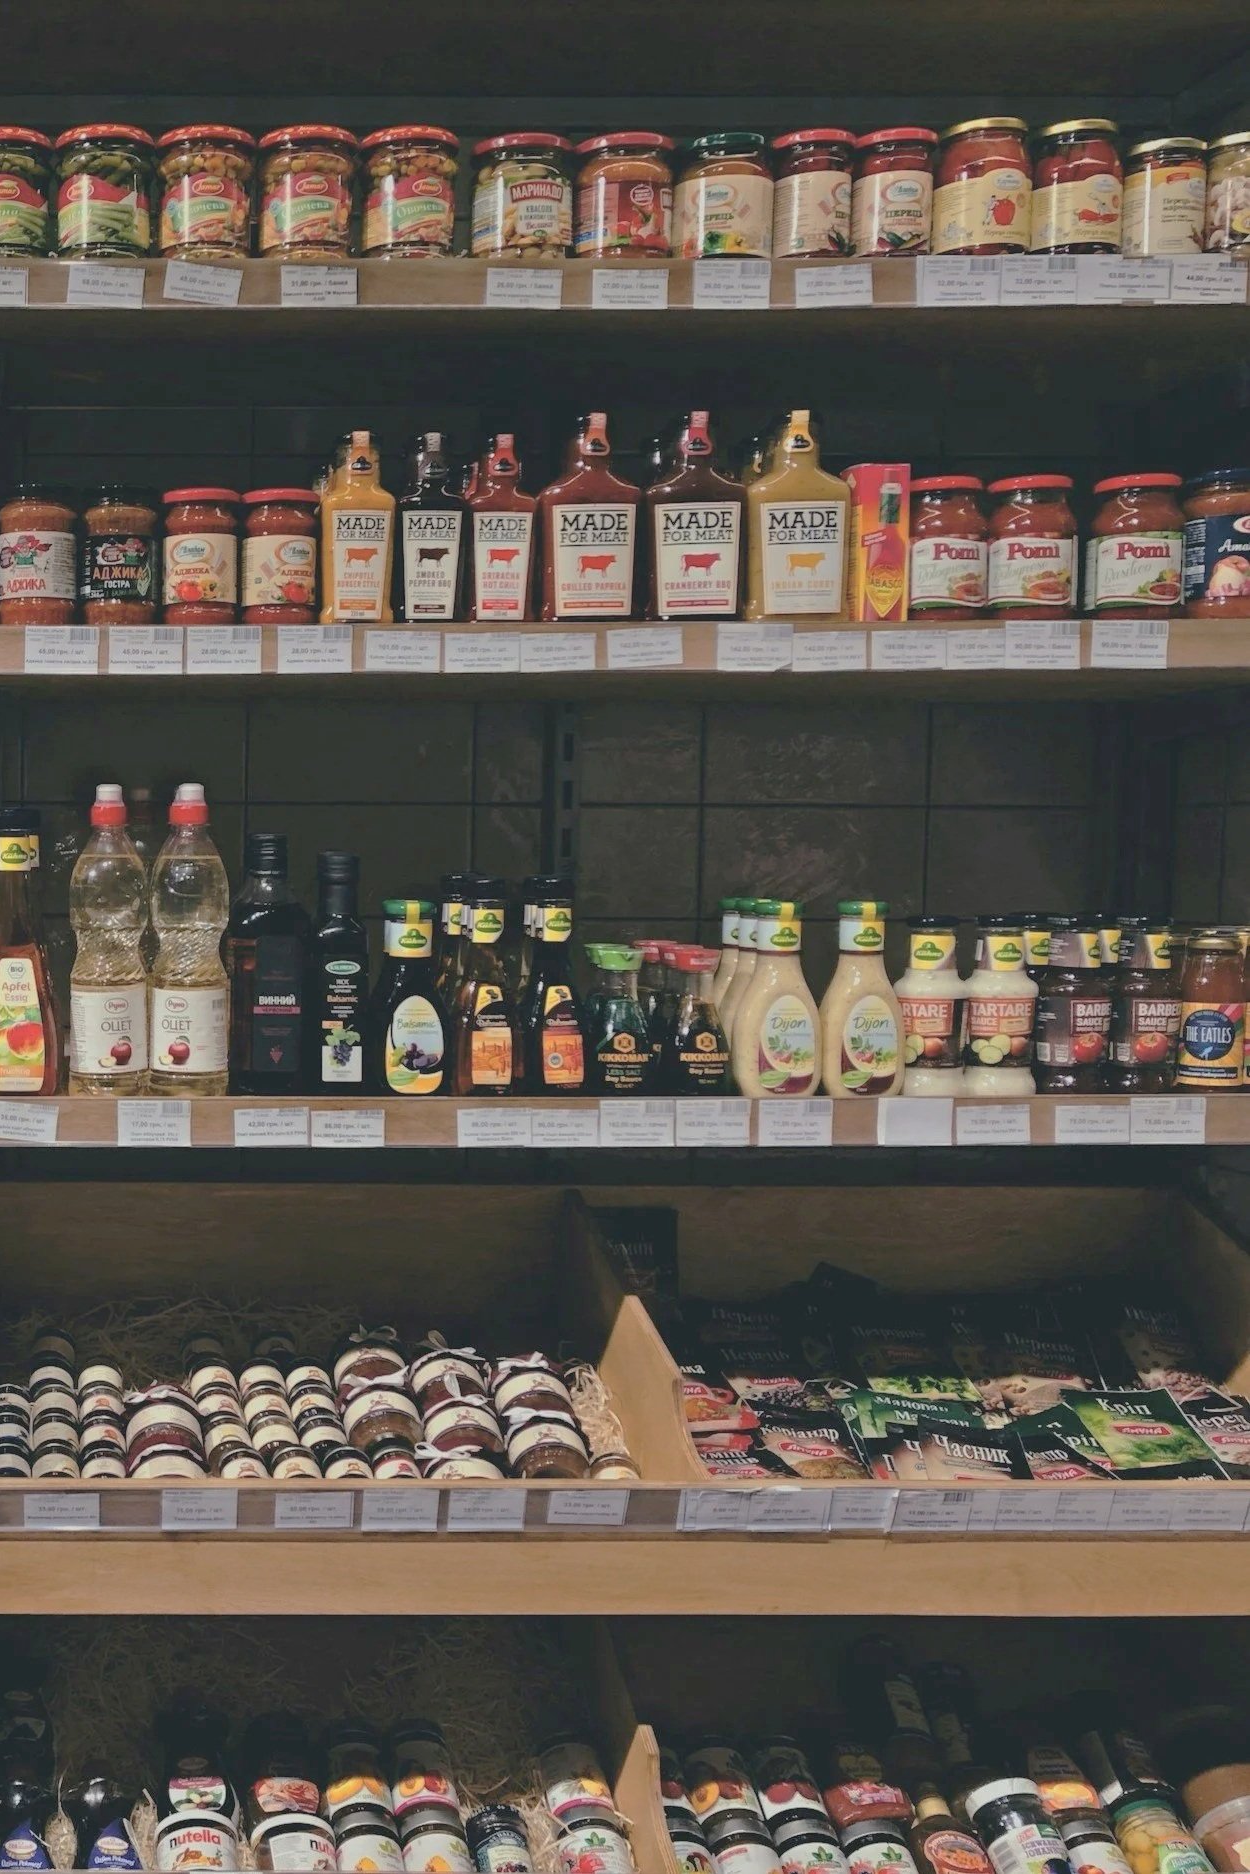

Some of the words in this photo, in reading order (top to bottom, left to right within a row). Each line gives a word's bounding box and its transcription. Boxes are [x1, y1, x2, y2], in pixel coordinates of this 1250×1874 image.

[512, 182, 563, 200] МАРИНАДО
[337, 517, 385, 530] MADE
[408, 517, 456, 530] MADE
[479, 519, 526, 531] MADE
[561, 514, 628, 531] MADE
[663, 511, 732, 530] MADE
[768, 511, 837, 529] MADE
[560, 532, 589, 543] FOR
[591, 531, 629, 543] MEAT
[663, 531, 693, 542] FOR
[696, 530, 733, 541] MEAT
[768, 530, 797, 541] FOR
[800, 529, 838, 540] MEAT
[93, 565, 144, 580] АДЖИКА
[173, 567, 210, 576] АДЖИКА
[482, 572, 520, 580] SRIRACHA
[7, 578, 46, 593] АДЖИКА
[104, 580, 130, 589] ГОСТРА
[561, 583, 592, 591] GRILLED
[595, 582, 626, 591] PAPRIKA
[664, 581, 713, 591] CRANBERRY
[716, 581, 731, 590] BBQ
[2, 981, 31, 993] Apfel
[4, 993, 28, 1003] Essig
[971, 1001, 1031, 1017] TARTARE
[101, 1020, 132, 1032] ОЦЕТ
[161, 1019, 192, 1031] ОЦЕТ
[770, 1016, 807, 1030] Dijon
[853, 1016, 889, 1030] Dijon
[1076, 1017, 1103, 1026] SAUCE
[1138, 1017, 1167, 1026] SAUCE
[1186, 1026, 1200, 1041] THE
[1201, 1026, 1232, 1044] EATLES
[598, 1053, 649, 1062] KIKKOMAN
[680, 1053, 729, 1062] KIKKOMAN
[1096, 1398, 1152, 1416] Кріп
[933, 1434, 1013, 1464] Часник
[169, 1830, 221, 1848] nutella
